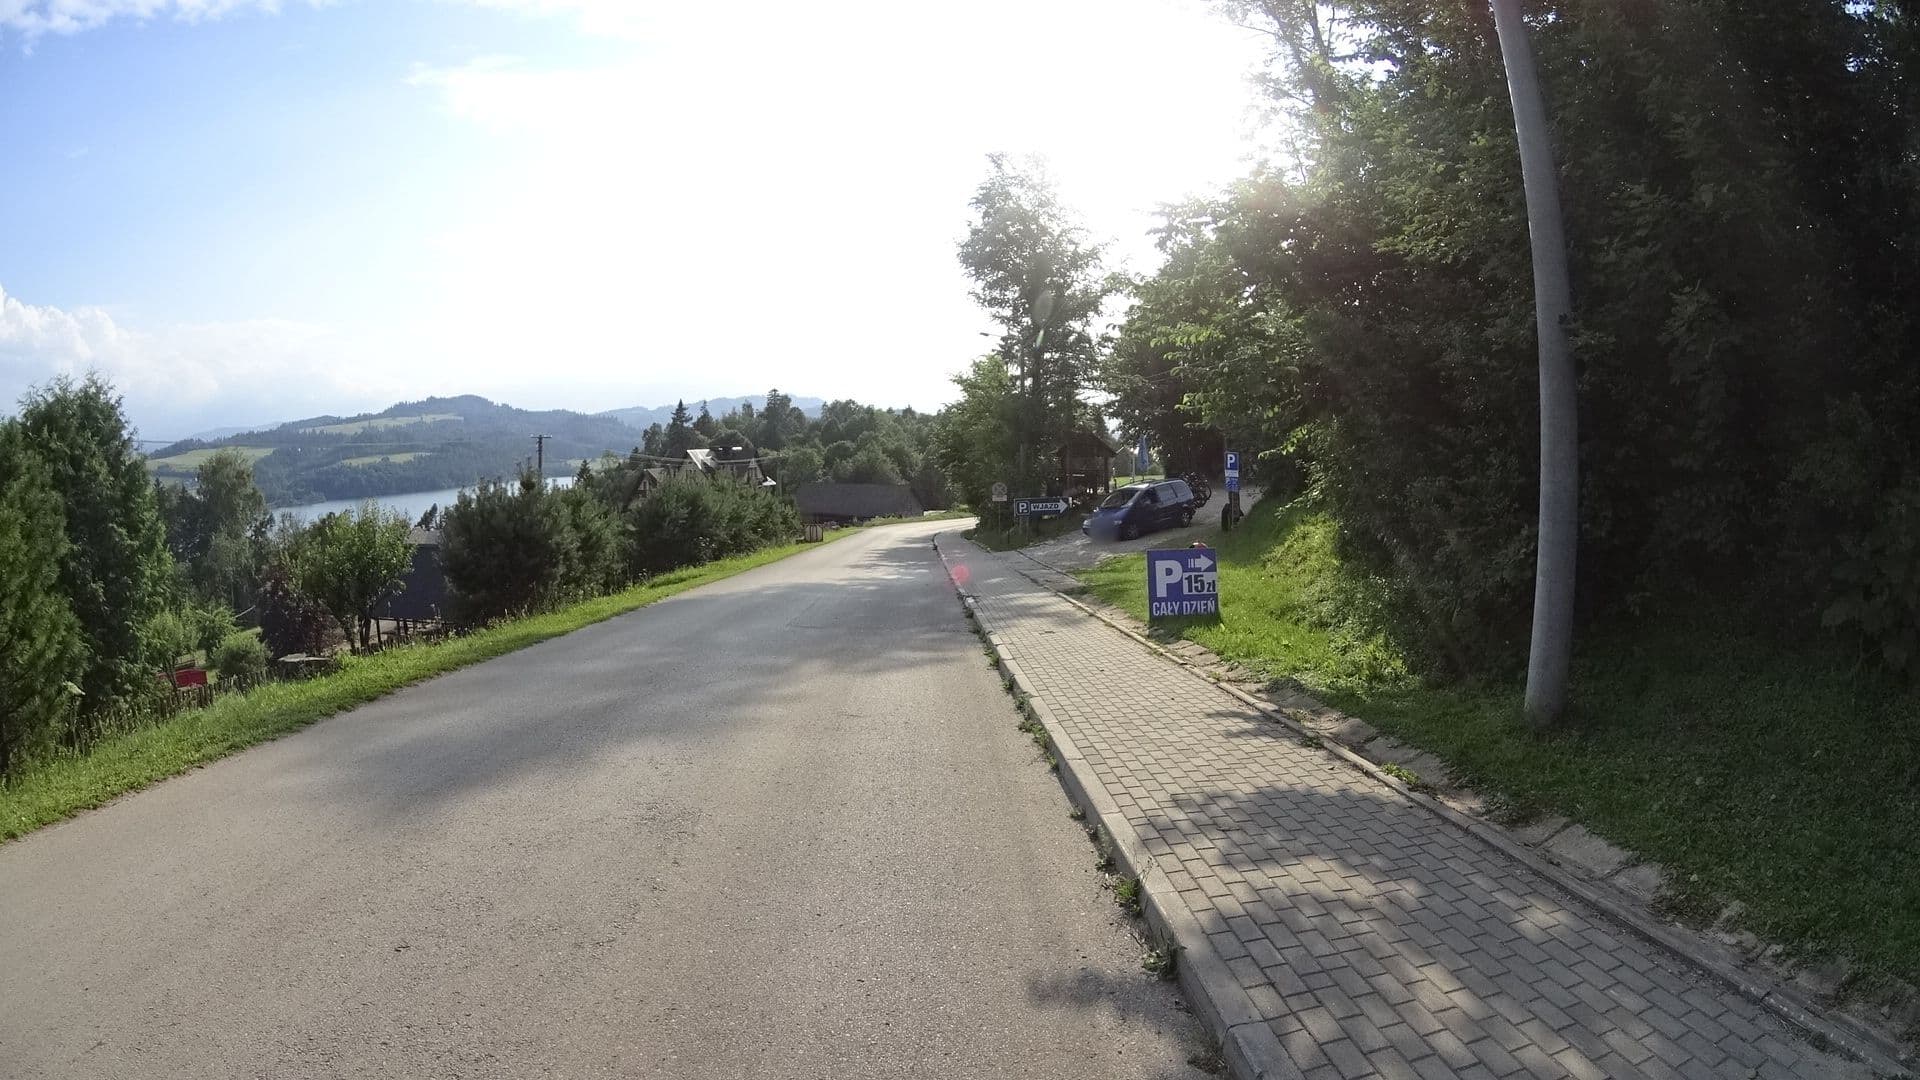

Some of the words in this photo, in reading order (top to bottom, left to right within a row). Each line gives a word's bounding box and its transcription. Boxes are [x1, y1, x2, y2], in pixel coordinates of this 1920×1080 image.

[1227, 454, 1236, 469] P
[1019, 502, 1027, 513] P
[1155, 560, 1183, 598] P
[1152, 601, 1180, 616] CAŁY
[1183, 598, 1215, 615] DZIEŃ
